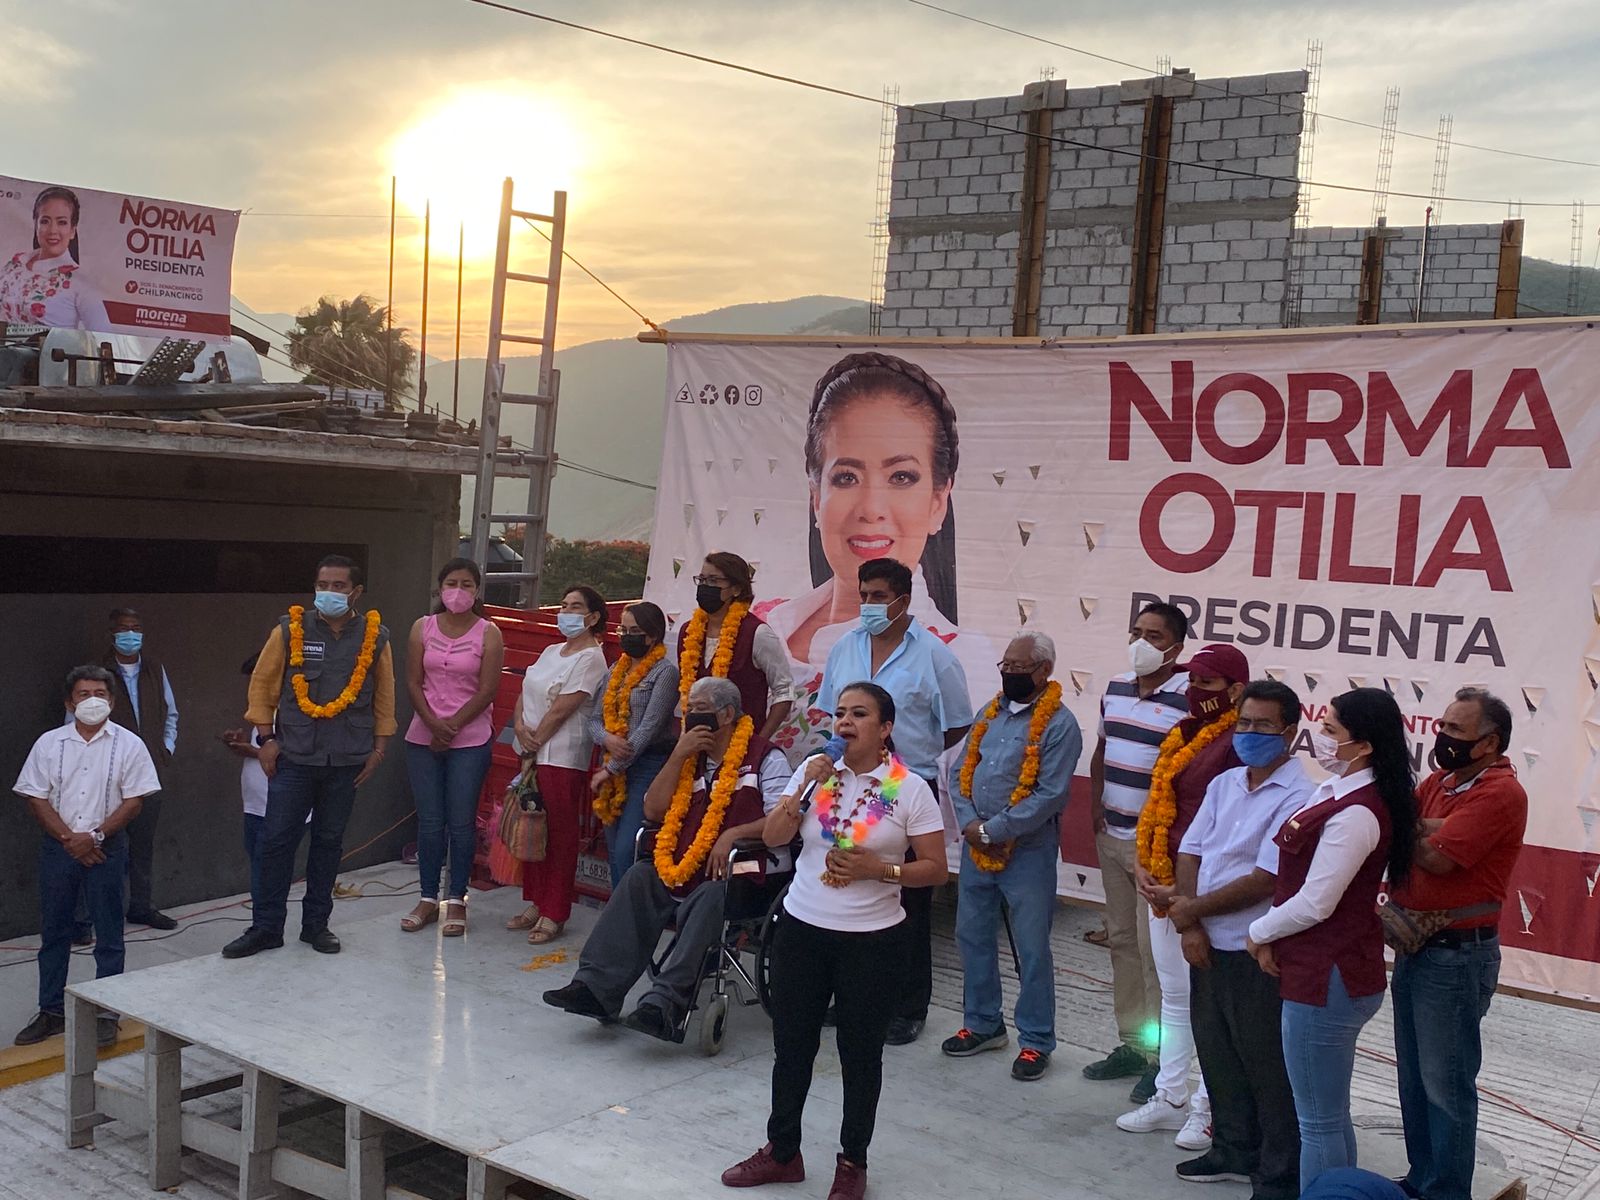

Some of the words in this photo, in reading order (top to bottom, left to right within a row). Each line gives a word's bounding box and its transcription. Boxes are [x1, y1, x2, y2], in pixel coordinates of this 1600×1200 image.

[119, 198, 216, 236] NORMA
[127, 228, 205, 261] OTILIA
[125, 257, 205, 277] PRESIDENTA
[138, 288, 204, 301] CHILPANCINGO
[136, 308, 187, 323] morena
[1109, 361, 1572, 469] NORMA
[1139, 472, 1514, 592] OTILIA
[1200, 697, 1219, 713] YAT
